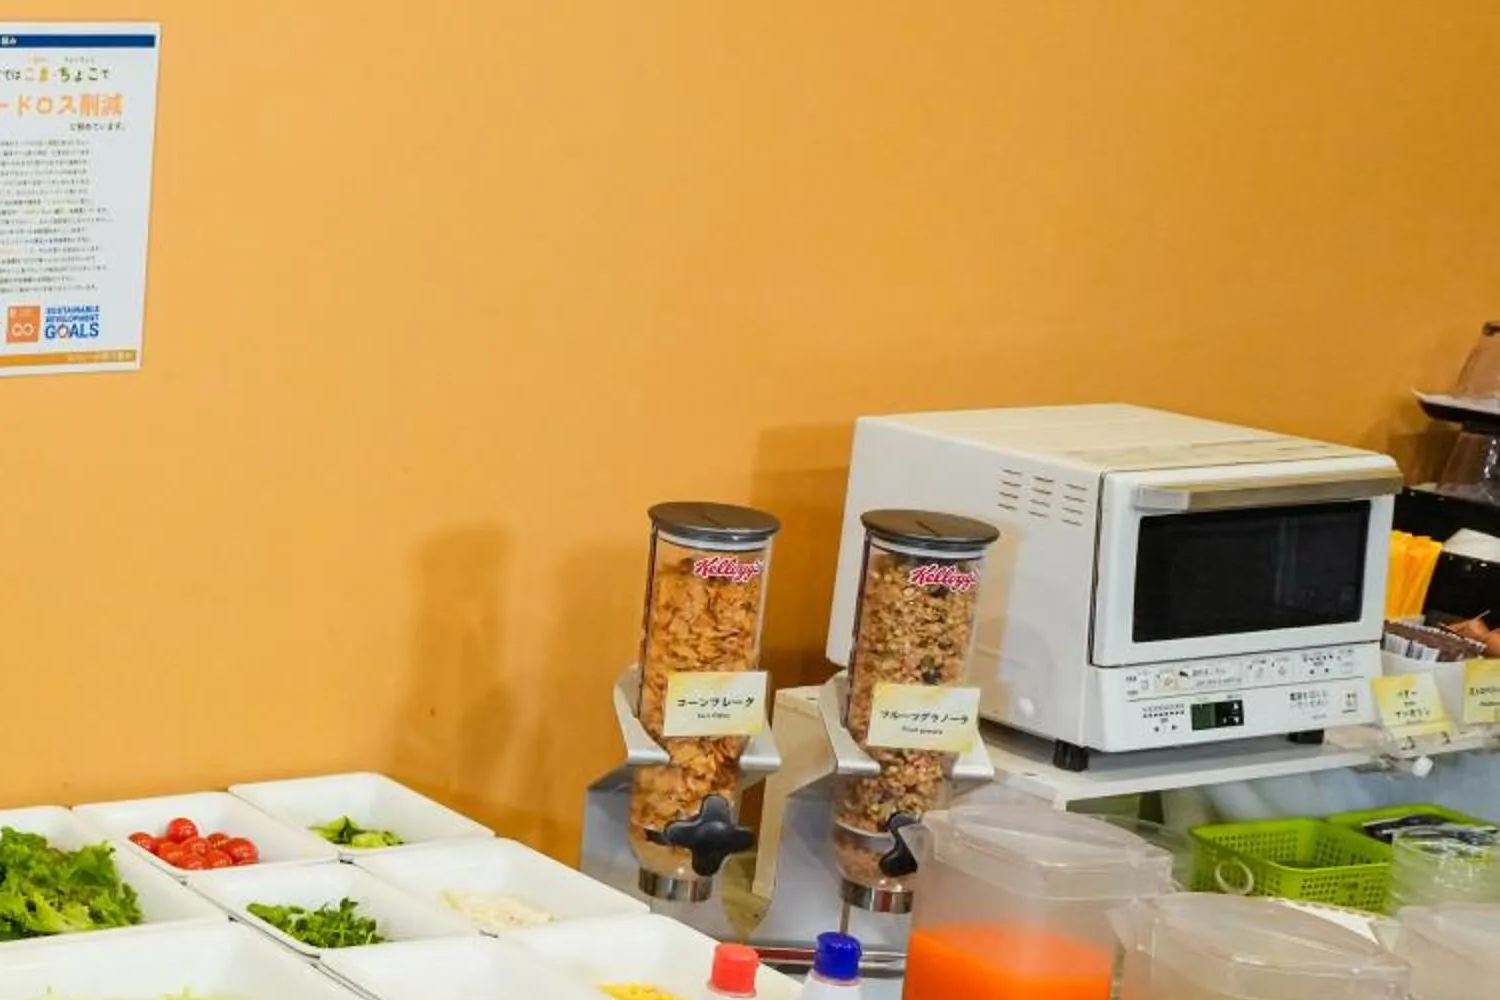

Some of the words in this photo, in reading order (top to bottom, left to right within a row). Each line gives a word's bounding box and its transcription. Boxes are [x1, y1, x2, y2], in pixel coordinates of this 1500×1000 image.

[45, 323, 100, 339] GOALS
[677, 696, 755, 708] コーンフレーク
